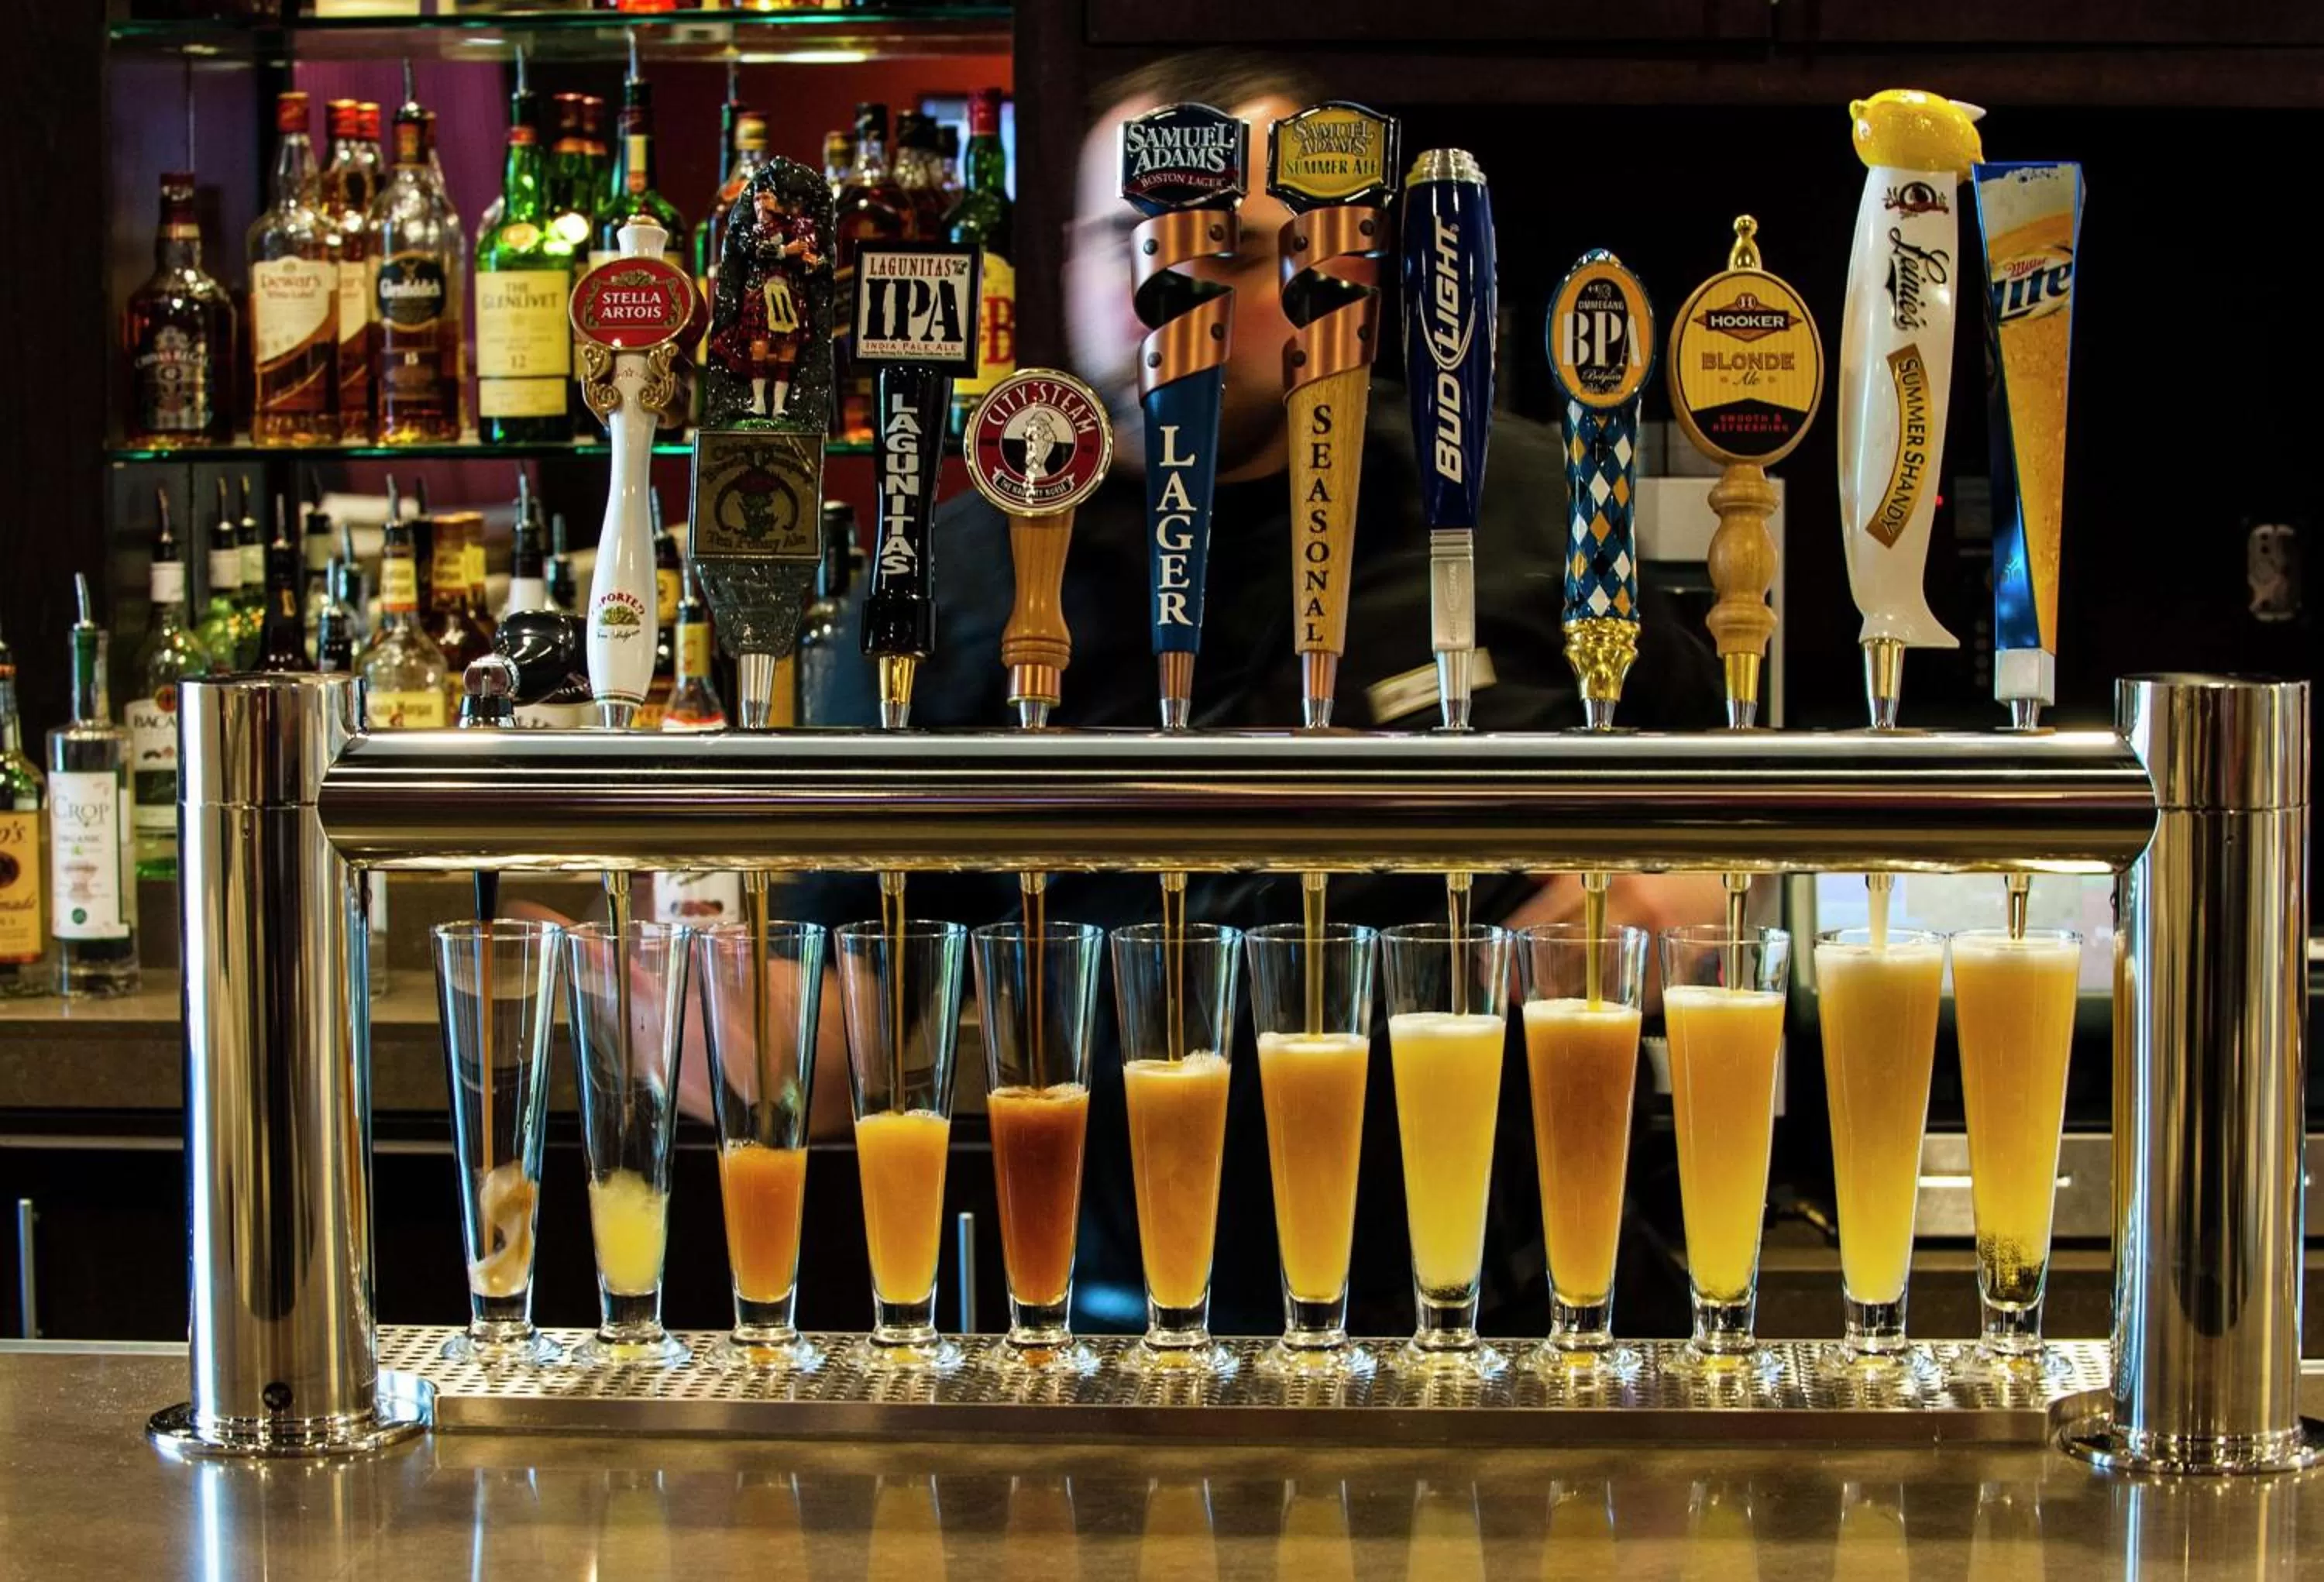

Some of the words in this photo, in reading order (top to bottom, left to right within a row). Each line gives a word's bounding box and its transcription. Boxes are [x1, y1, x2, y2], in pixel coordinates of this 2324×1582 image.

[1127, 122, 1235, 152] SAMUEL
[1292, 120, 1375, 141] SAMUEL
[1133, 146, 1226, 177] ADAMS
[1298, 138, 1368, 159] ADAMS
[1140, 173, 1187, 187] BOSTON
[1286, 160, 1348, 174] SUMMER
[1354, 159, 1377, 174] ALE
[870, 257, 951, 277] LAGUNITAS
[1888, 227, 1950, 329] Leinie's
[602, 292, 662, 304] STELLA
[1435, 215, 1460, 355] LIGHT
[1992, 262, 2073, 323] Lite
[601, 307, 662, 319] ARTOIS
[863, 278, 964, 342] IPA
[1710, 315, 1785, 328] HOOKER
[866, 342, 896, 350] INDIA
[902, 342, 931, 351] PALE
[937, 343, 958, 352] ALE
[1563, 311, 1642, 368] BPA
[511, 355, 527, 370] 12
[1702, 353, 1795, 370] BLONDE
[987, 386, 1027, 425] CITY
[1039, 383, 1098, 435] STEAM
[1899, 359, 1925, 447] SUMMER
[1435, 371, 1463, 484] BUD
[880, 393, 923, 575] LAGUNITAS
[1881, 449, 1925, 535] SHANDY
[1156, 425, 1197, 626] LAGER
[1305, 404, 1332, 642] SEASONAL
